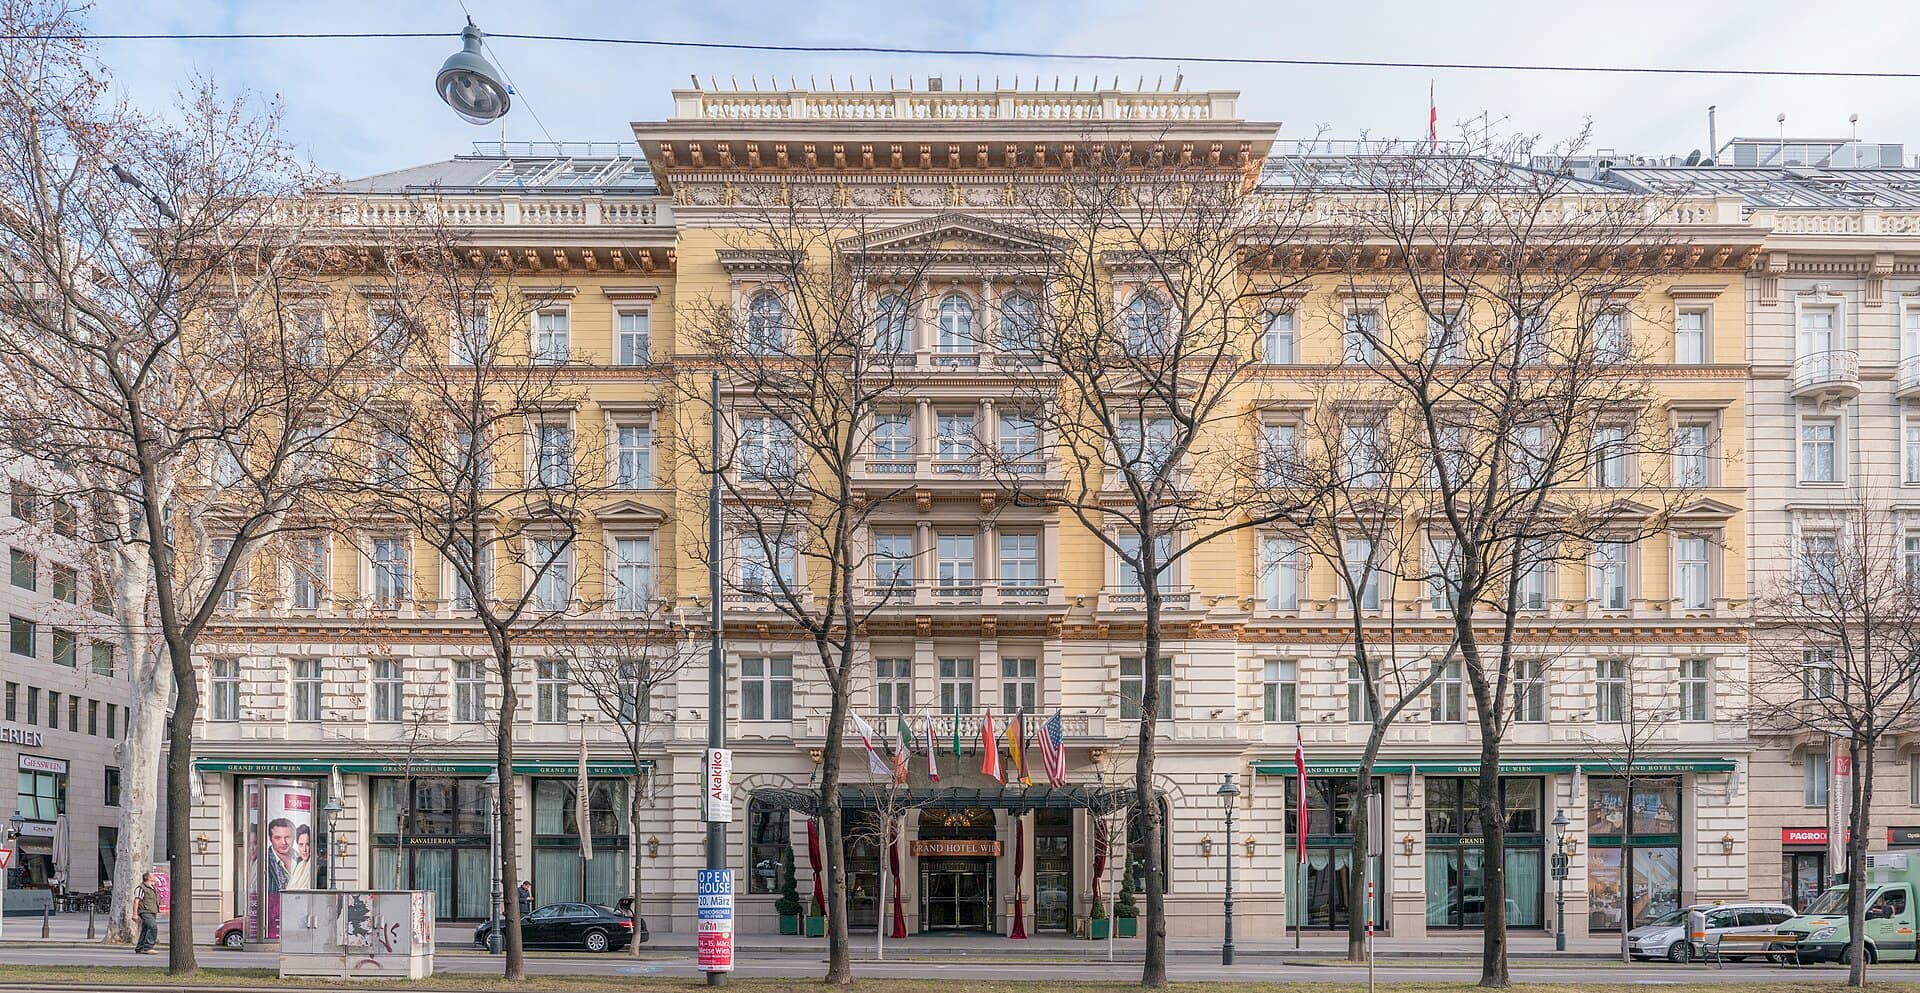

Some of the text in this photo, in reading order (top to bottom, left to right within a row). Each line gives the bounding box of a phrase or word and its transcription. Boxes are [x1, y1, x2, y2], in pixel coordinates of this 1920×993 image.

[711, 751, 722, 800] Akakiko
[912, 844, 1001, 853] GRAND HOTEL WIEN
[698, 871, 730, 883] OPEN
[699, 882, 730, 894] HOUSE
[699, 896, 730, 906] 20. März
